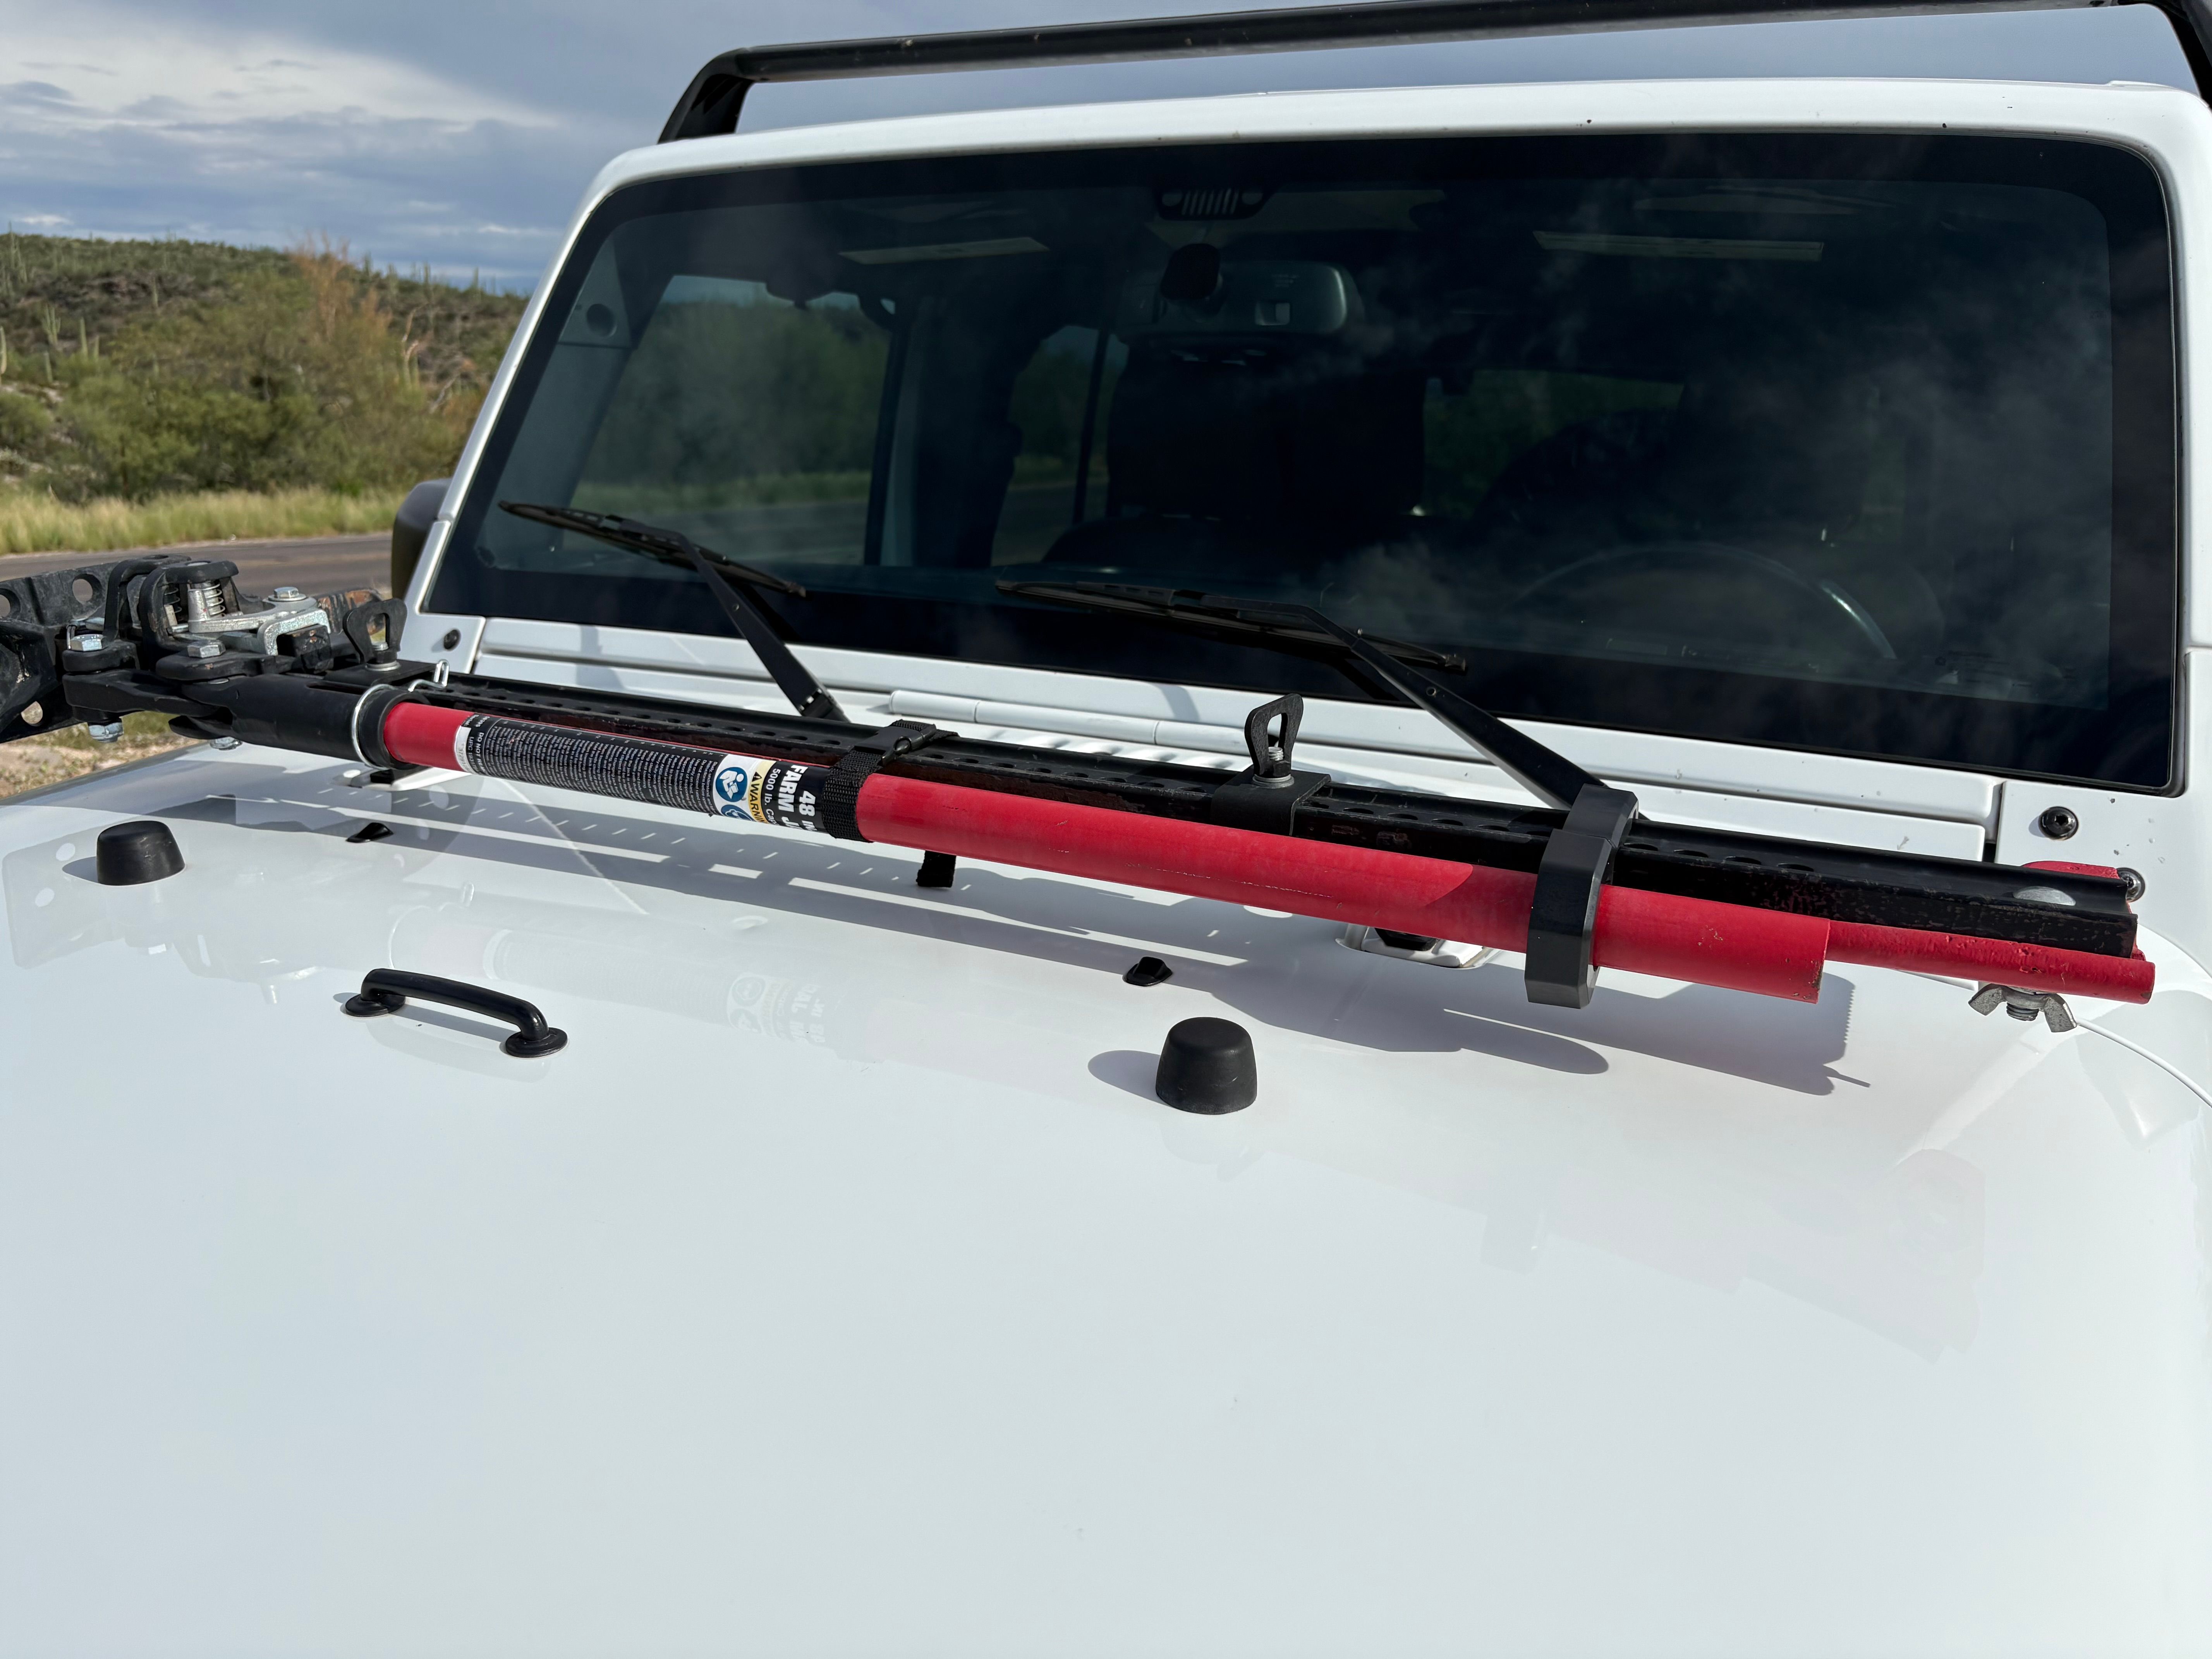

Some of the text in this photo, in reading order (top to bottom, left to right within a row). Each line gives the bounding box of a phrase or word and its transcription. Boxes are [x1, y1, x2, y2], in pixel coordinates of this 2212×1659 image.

[477, 732, 484, 742] DO
[766, 768, 781, 790] 5000
[778, 764, 808, 812] FARM
[764, 793, 773, 805] lb.
[799, 790, 816, 816] 48
